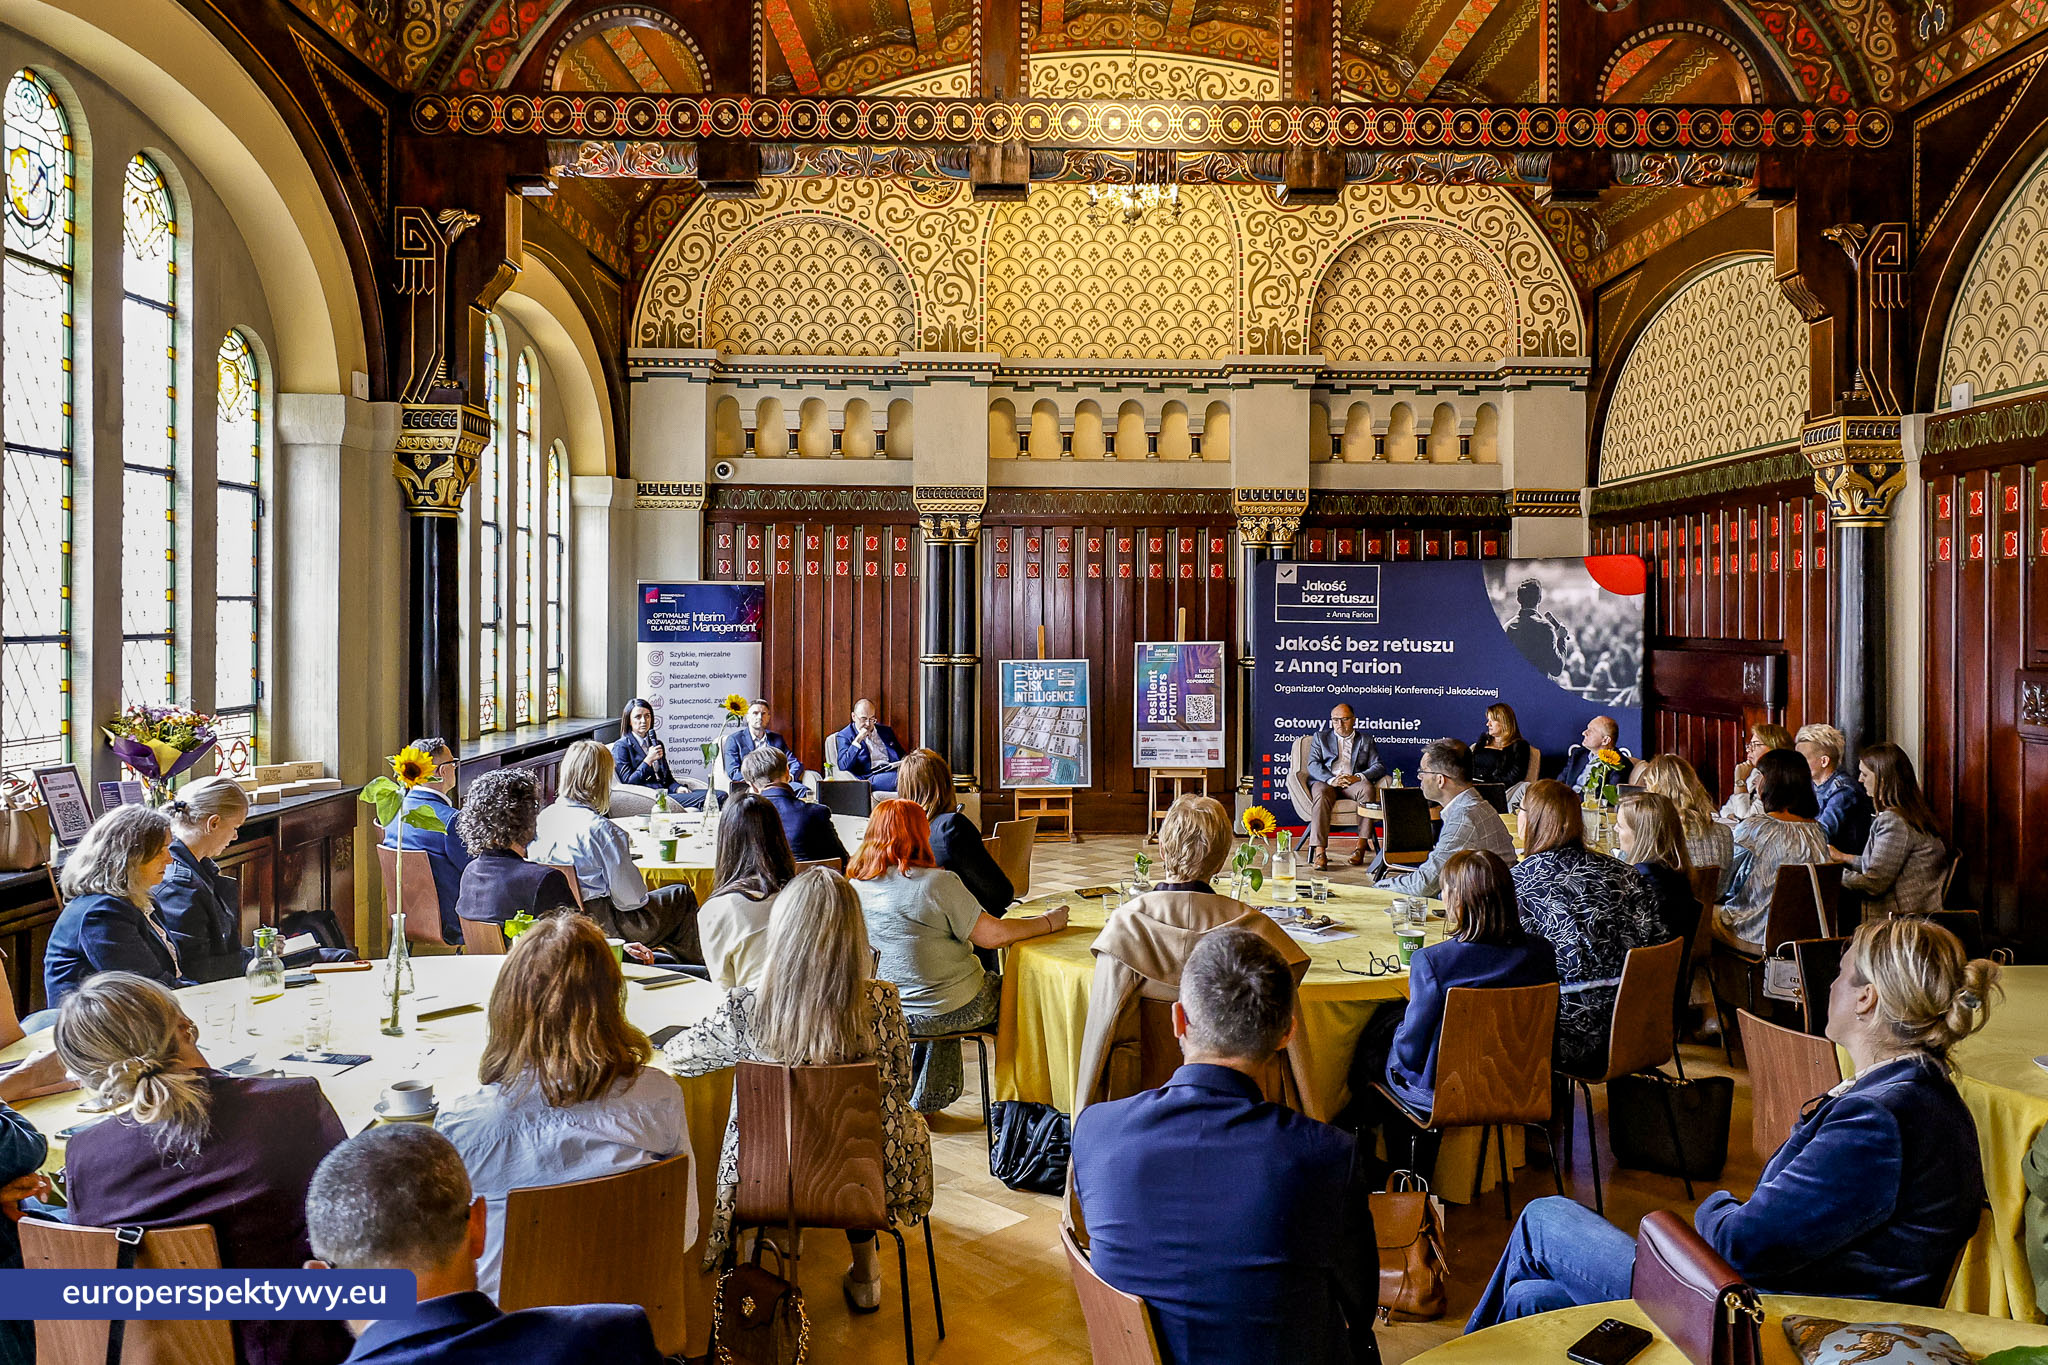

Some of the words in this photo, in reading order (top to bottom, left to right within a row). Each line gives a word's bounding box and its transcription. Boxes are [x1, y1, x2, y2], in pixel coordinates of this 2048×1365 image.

[1302, 580, 1347, 592] Jakość
[1301, 592, 1325, 603] bez
[1326, 593, 1375, 604] retuszu
[692, 611, 726, 622] Interim
[1332, 611, 1351, 619] Anną
[692, 622, 756, 634] Management
[1275, 635, 1342, 651] Jakość
[1346, 636, 1379, 652] bez
[1383, 638, 1454, 653] retuszu
[669, 660, 699, 668] rezultaty
[1275, 660, 1284, 673] z
[1288, 659, 1338, 677] Anną
[1342, 658, 1402, 674] Farion
[708, 673, 747, 681] obiektywne
[1014, 669, 1055, 681] PEOPLE
[669, 682, 710, 690] partnerstwo
[1014, 680, 1043, 692] RISK
[1274, 683, 1325, 695] Organizator
[1327, 684, 1393, 695] Ogólnopolskiej
[1394, 685, 1444, 696] Konferencji
[1445, 686, 1499, 698] Jakościowej
[1014, 691, 1075, 703] INTELLIGENCE
[1147, 670, 1158, 723] Resilient
[1157, 673, 1168, 723] Leaders
[1167, 683, 1177, 723] Forum
[668, 722, 710, 730] sprawdzone
[1274, 717, 1327, 732] Gotowy
